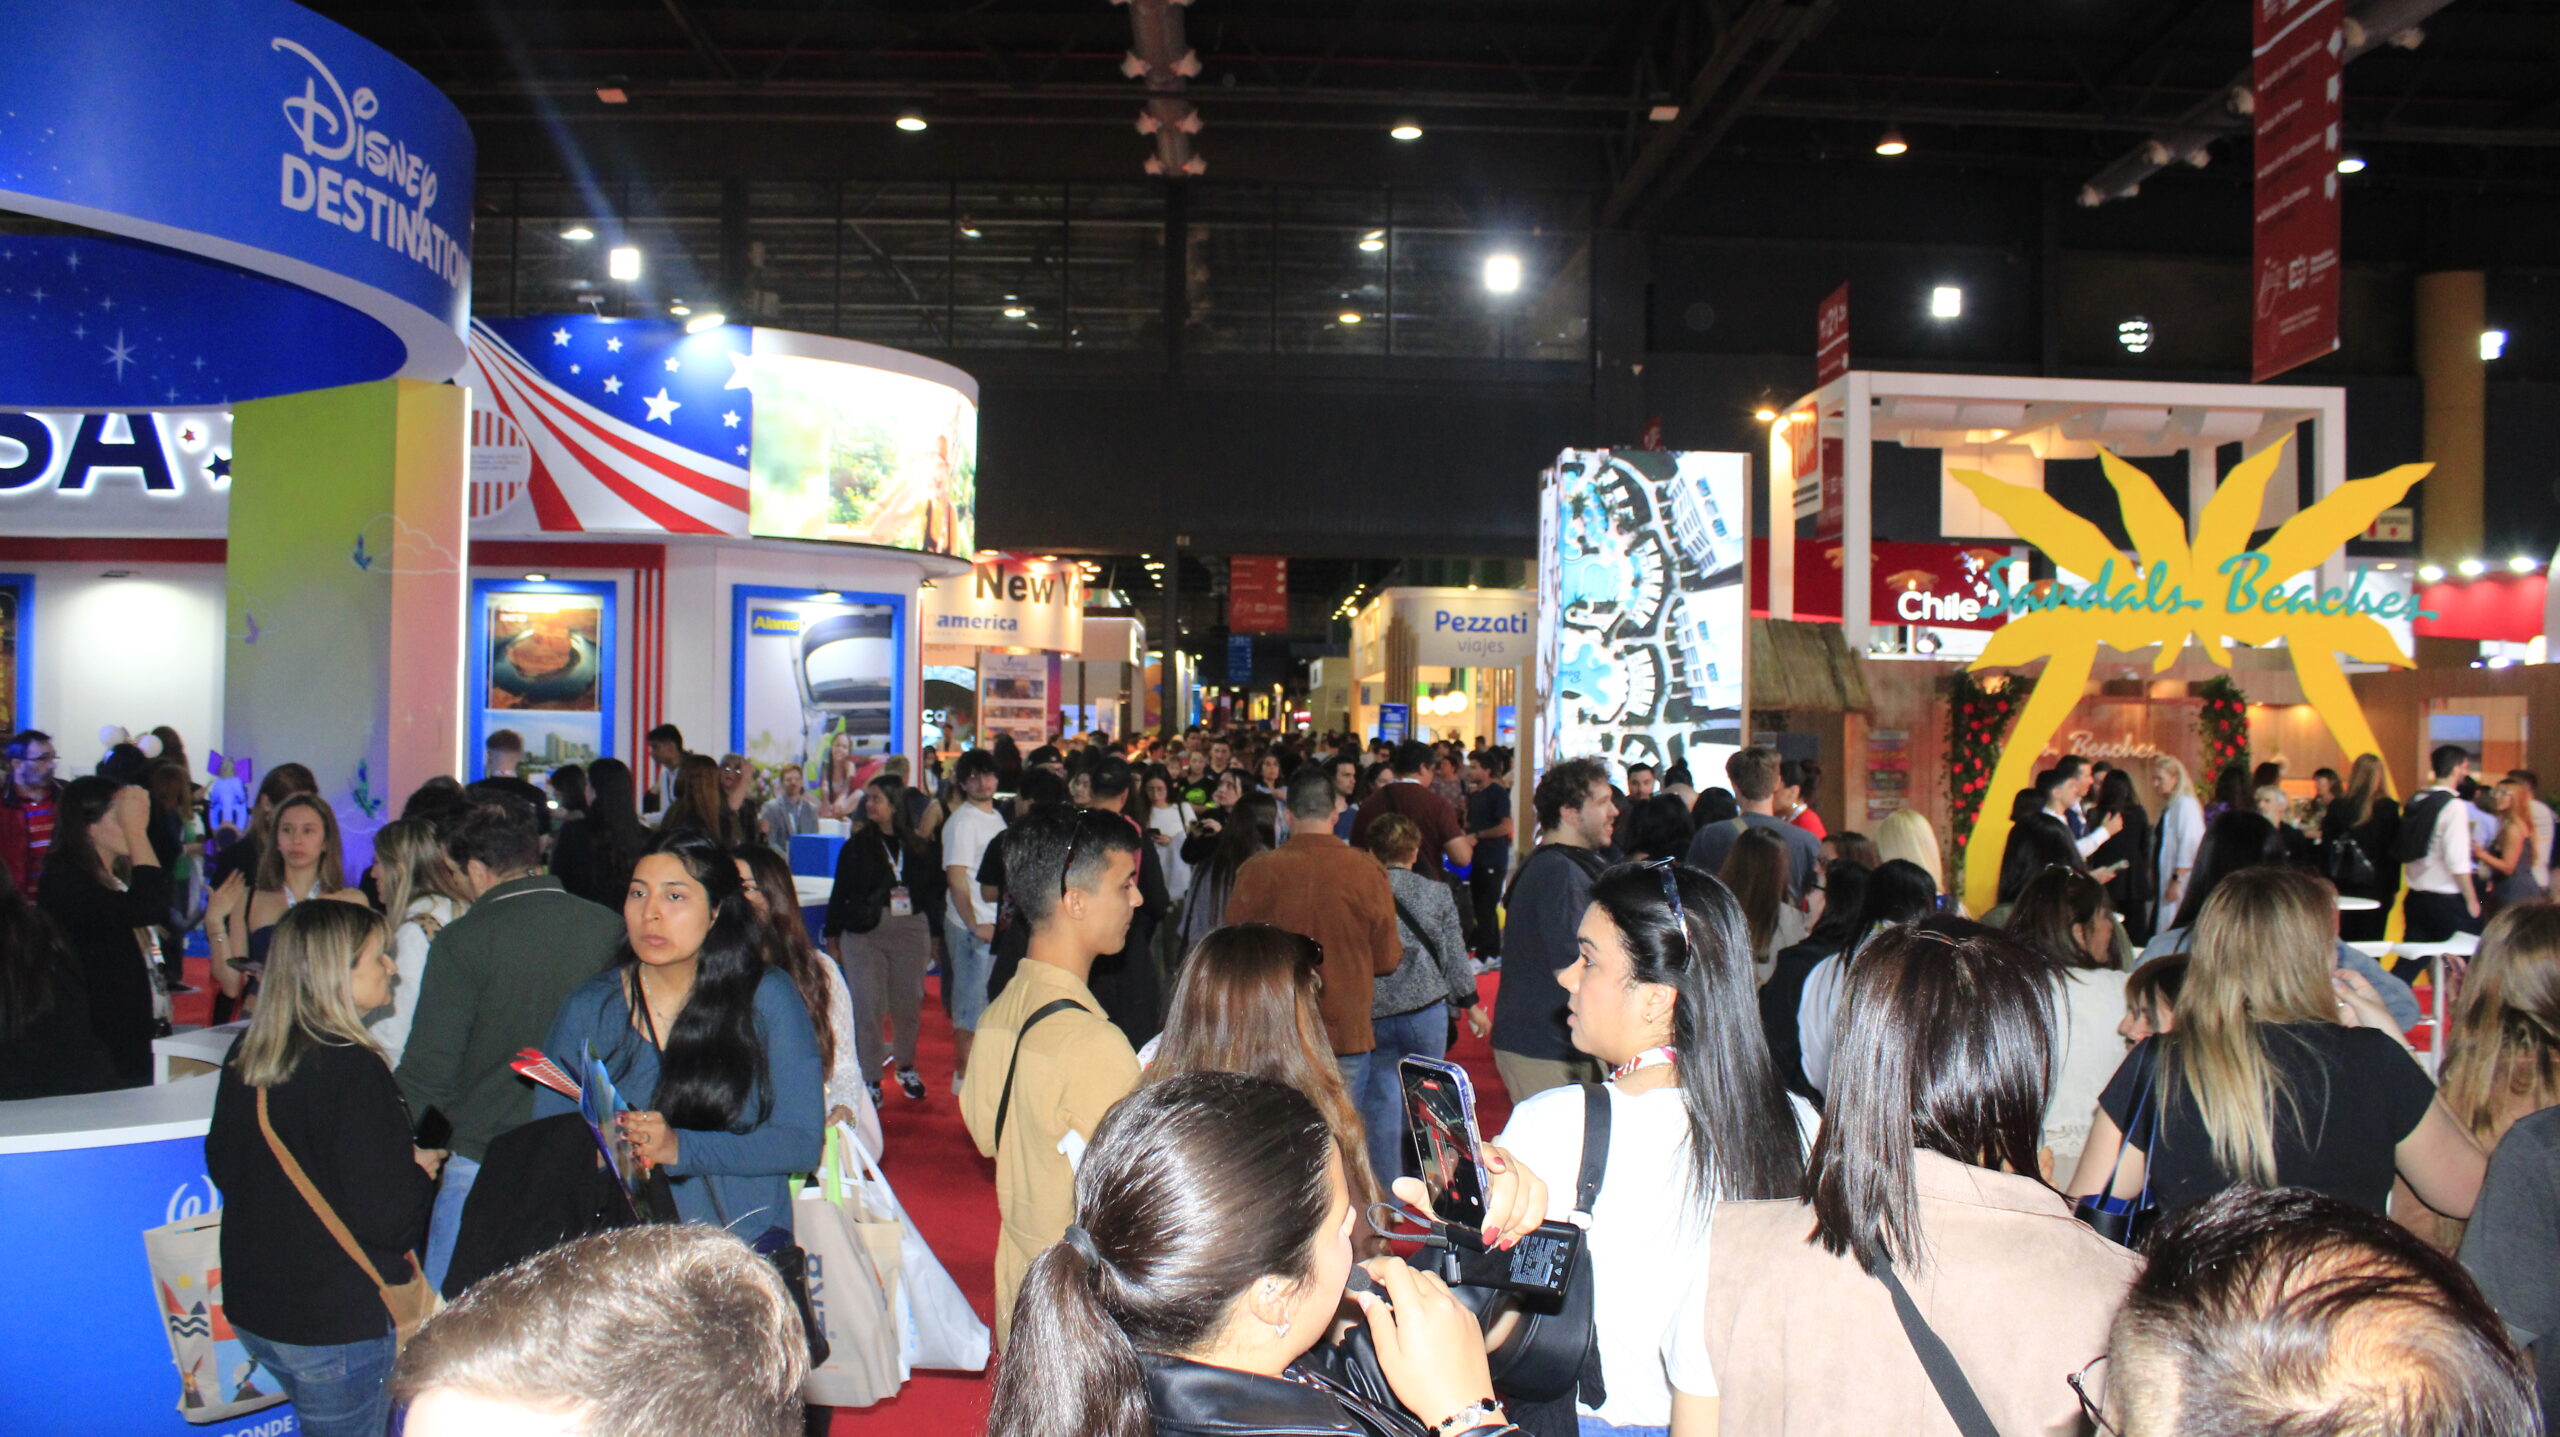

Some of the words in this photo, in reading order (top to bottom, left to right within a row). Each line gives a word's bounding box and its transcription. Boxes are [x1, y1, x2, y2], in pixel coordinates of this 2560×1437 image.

[976, 562, 1055, 605] New
[1978, 556, 2205, 618] Sandals
[2217, 550, 2440, 622] Beaches
[1898, 590, 1981, 622] Chile
[936, 613, 1018, 631] america
[1435, 610, 1528, 633] Pezzati
[1457, 638, 1505, 657] viajes
